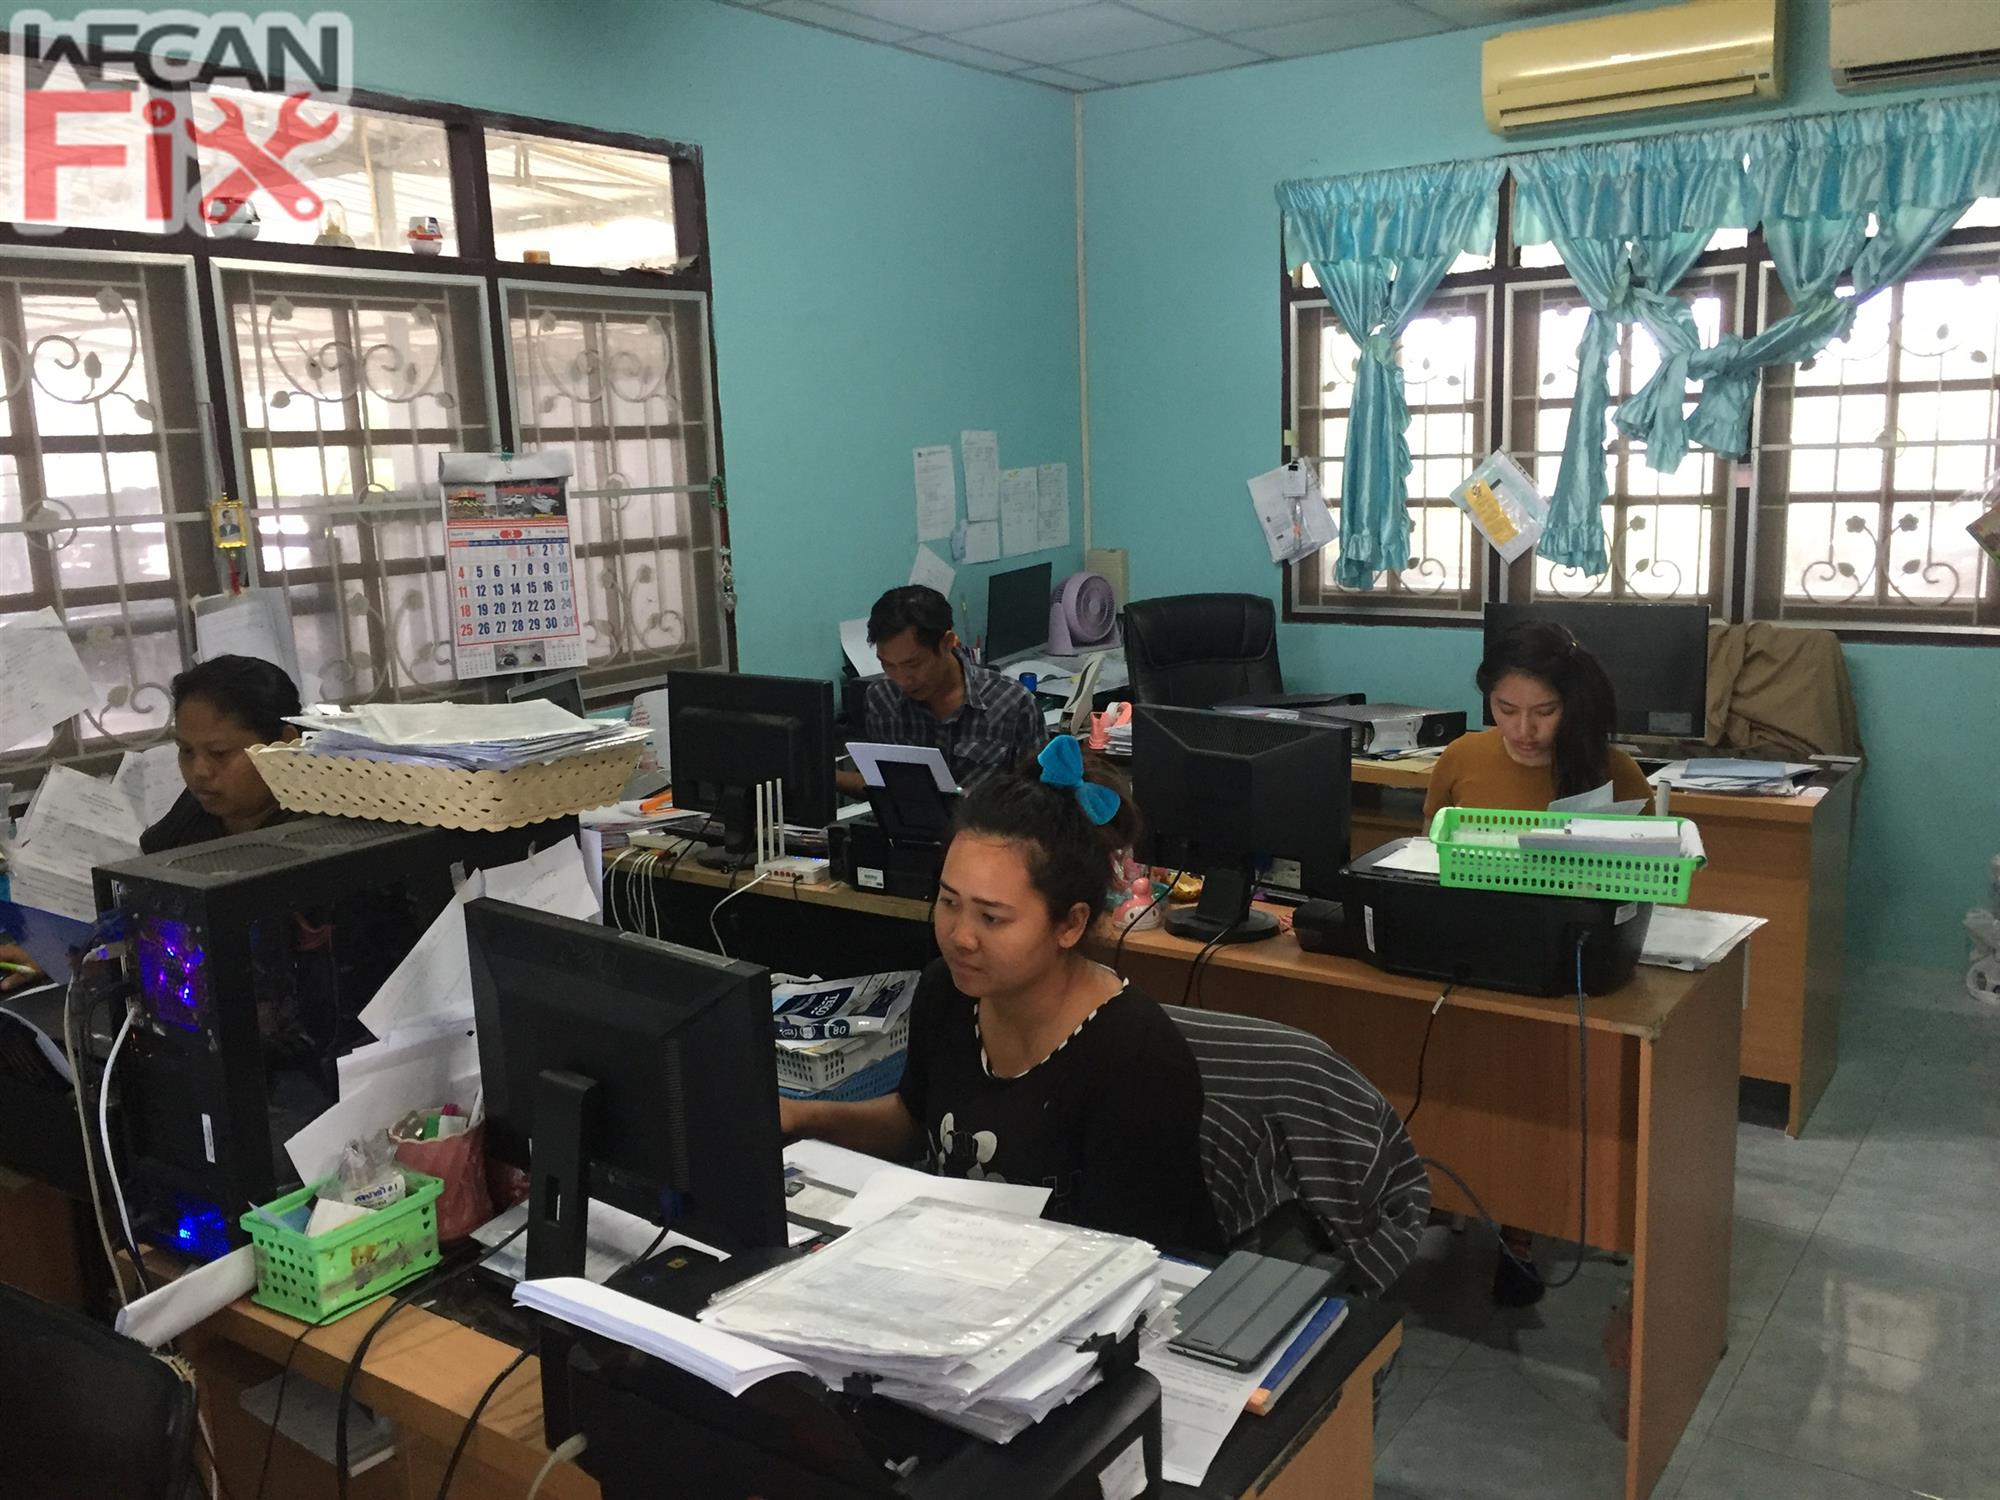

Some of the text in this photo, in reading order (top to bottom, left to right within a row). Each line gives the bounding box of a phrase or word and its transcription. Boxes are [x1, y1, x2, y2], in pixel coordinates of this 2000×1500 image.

[526, 544, 564, 556] 1 2 3
[458, 562, 568, 579] 4 5 6 7 8 9 10
[458, 580, 569, 598] 11 12 13 14 15 16 17
[460, 598, 571, 617] 18 19 20 21 22 23 24
[461, 616, 573, 636] 25 26 27 28 29 30 31
[833, 1025, 847, 1035] 80
